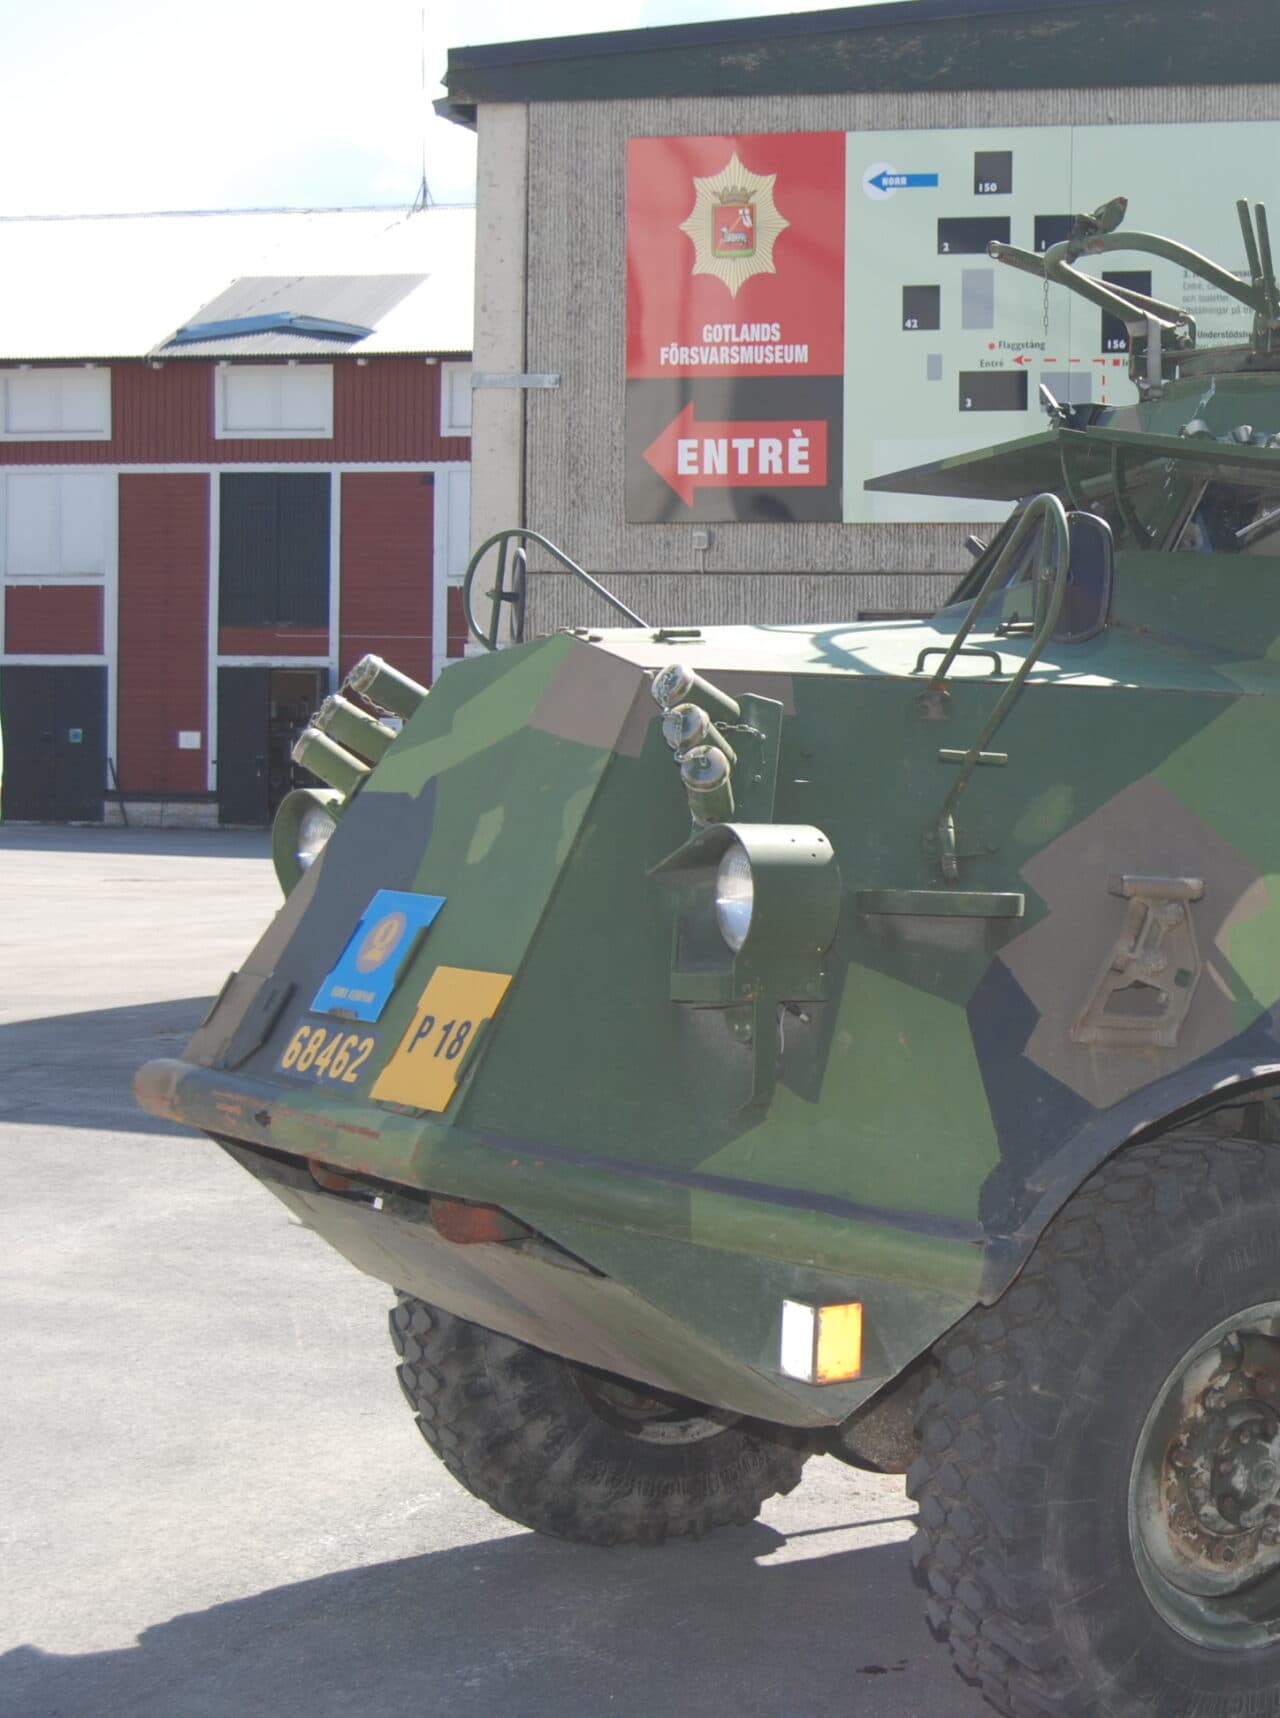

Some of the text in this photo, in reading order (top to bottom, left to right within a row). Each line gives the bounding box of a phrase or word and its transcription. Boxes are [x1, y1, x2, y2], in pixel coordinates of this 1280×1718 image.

[978, 182, 997, 192] 150
[703, 323, 781, 343] GOTLANDS
[905, 319, 918, 328] 42
[660, 342, 809, 366] FÖRSVARSMUSEUM
[998, 340, 1046, 351] Flaggstång
[1107, 339, 1126, 349] 156
[677, 428, 810, 475] ENTRÈ
[407, 1015, 473, 1060] P 18
[281, 1025, 375, 1083] 68462
